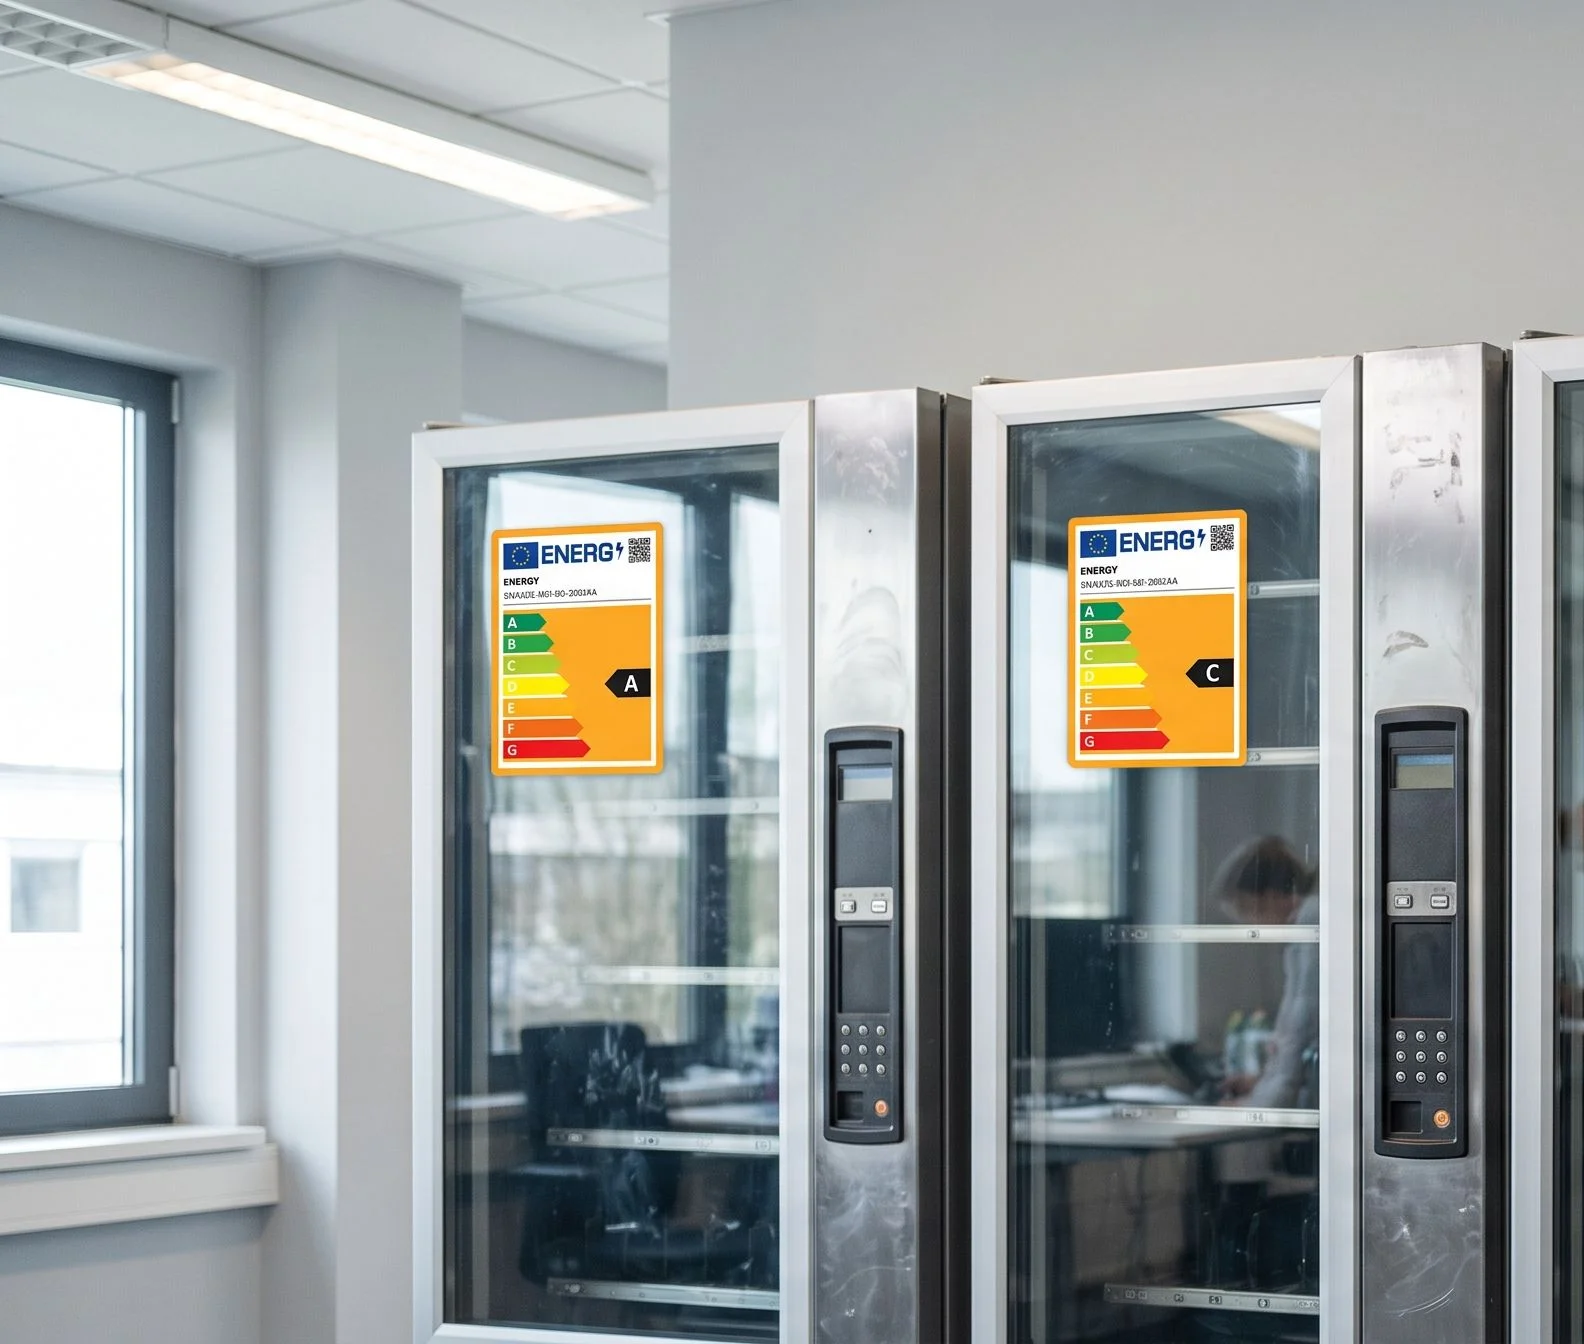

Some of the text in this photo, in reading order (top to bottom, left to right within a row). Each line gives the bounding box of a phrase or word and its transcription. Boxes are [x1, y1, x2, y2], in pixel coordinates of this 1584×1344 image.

[1080, 565, 1119, 575] ENERGY
[503, 576, 540, 586] ENERGY
[1084, 606, 1095, 618] A
[507, 617, 518, 629] A
[1085, 628, 1094, 639] B
[507, 638, 516, 650] B
[1084, 649, 1093, 661] C
[507, 660, 516, 671] C
[1084, 671, 1095, 682] D
[1205, 663, 1220, 682] C
[507, 681, 517, 692] D
[623, 674, 639, 692] A
[1084, 693, 1093, 704] E
[507, 702, 515, 714] E
[1084, 714, 1093, 725] F
[507, 723, 515, 734] F
[1084, 736, 1095, 747] G
[507, 744, 517, 756] G
